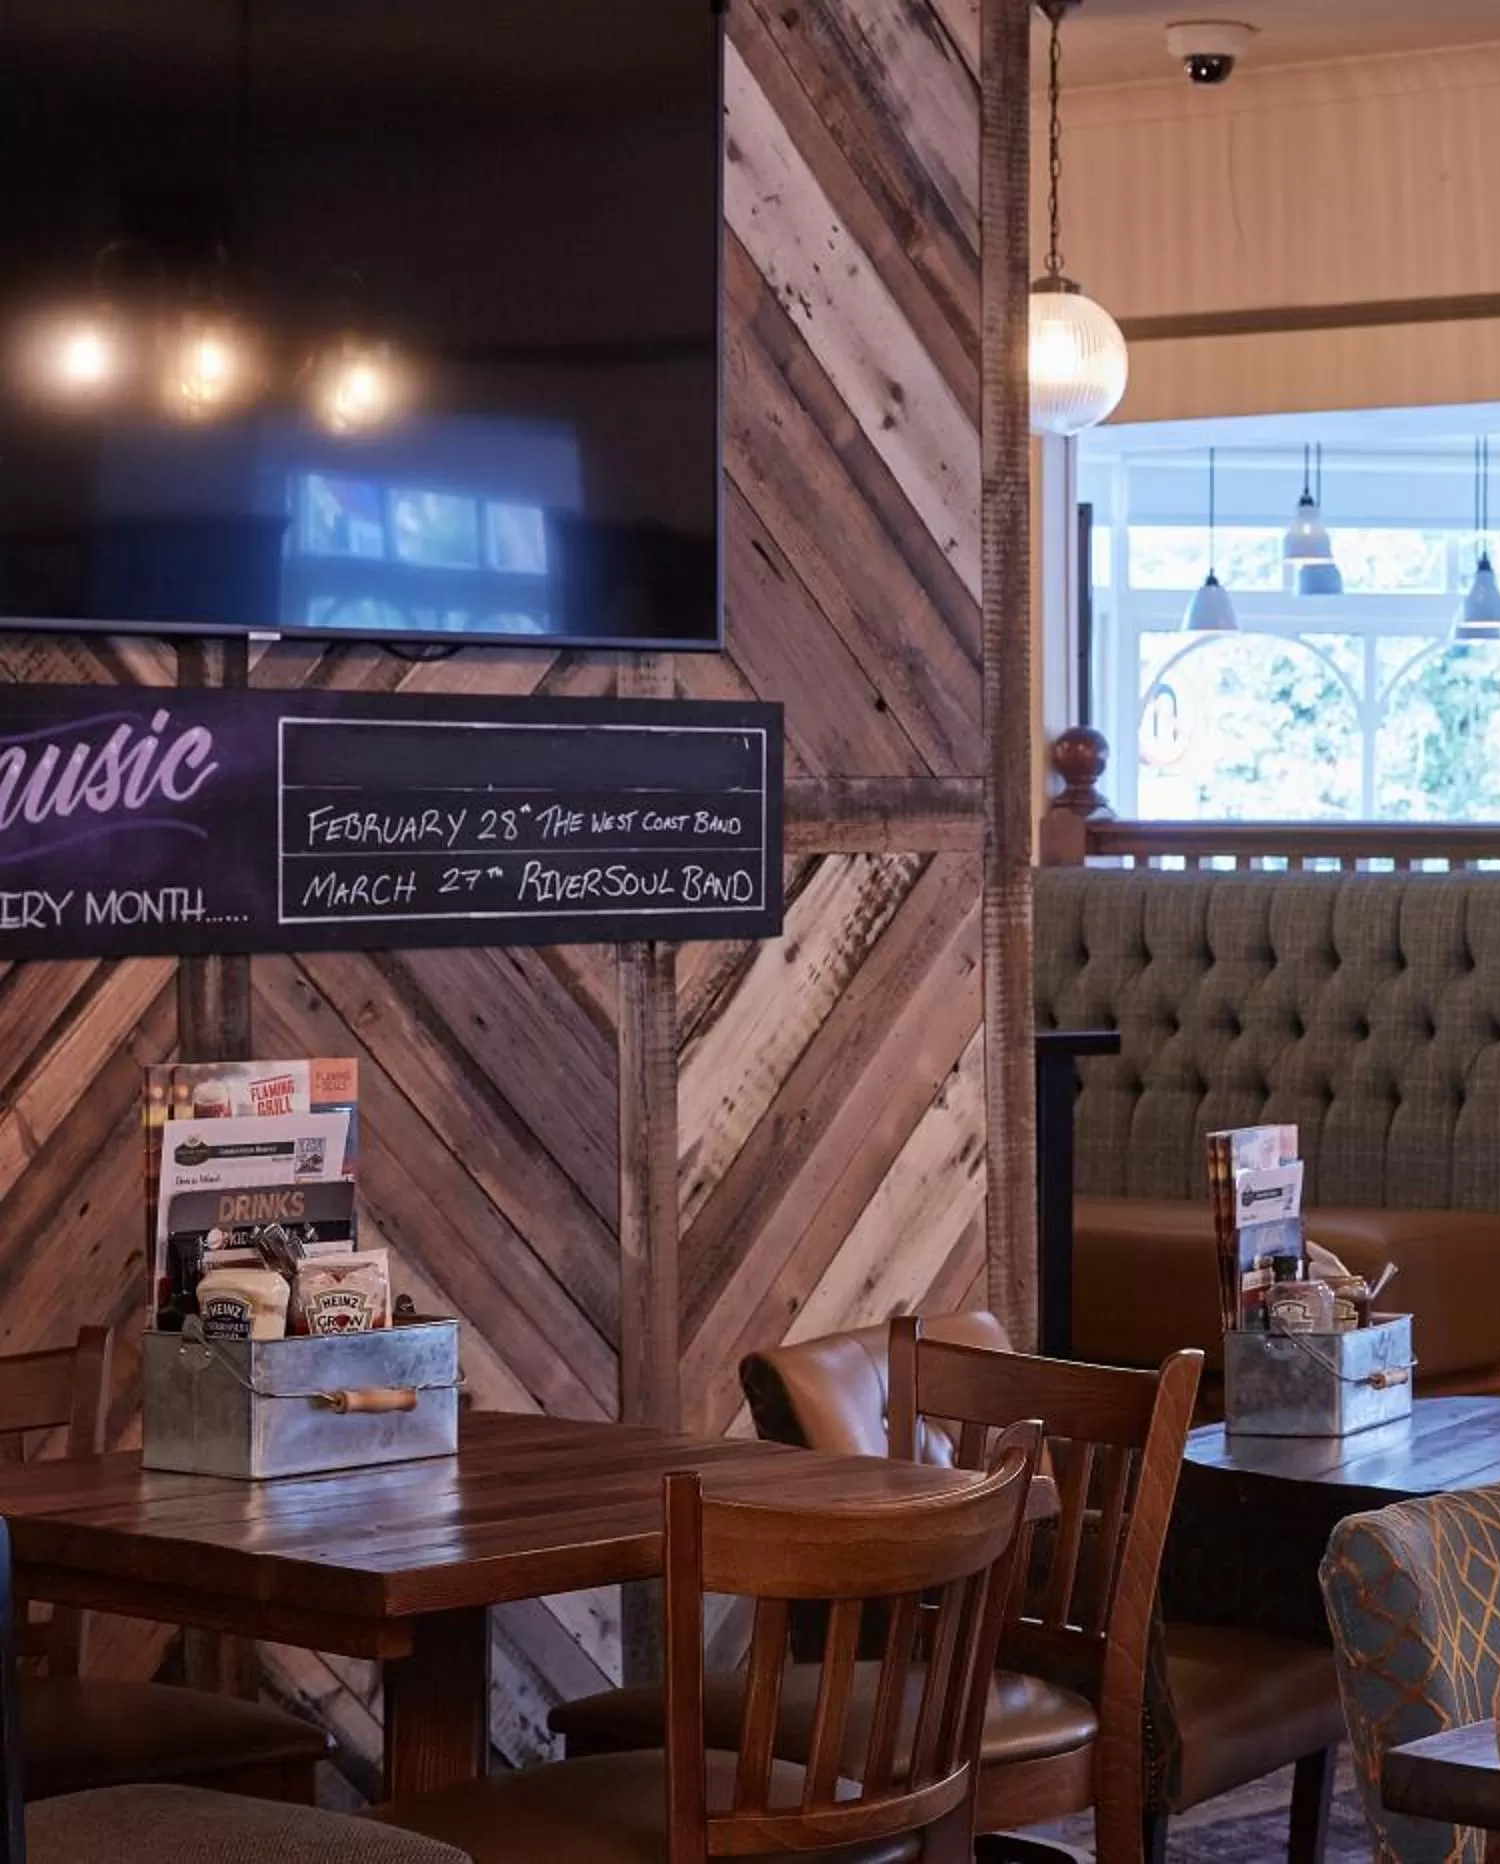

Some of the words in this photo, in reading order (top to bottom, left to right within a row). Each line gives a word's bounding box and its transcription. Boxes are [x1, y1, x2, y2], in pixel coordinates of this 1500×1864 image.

[307, 805, 467, 847] FEBRUARY
[536, 804, 585, 839] THE
[591, 810, 639, 833] WEST
[642, 811, 691, 832] COAST
[694, 811, 742, 835] BAND
[302, 871, 416, 908] MARCH
[682, 865, 754, 902] BAND
[250, 1080, 295, 1102] FLAMING
[257, 1095, 293, 1117] GRILL
[217, 1192, 305, 1223] DRINKS
[209, 1303, 243, 1318] HEINZ
[321, 1295, 360, 1309] HEINZ
